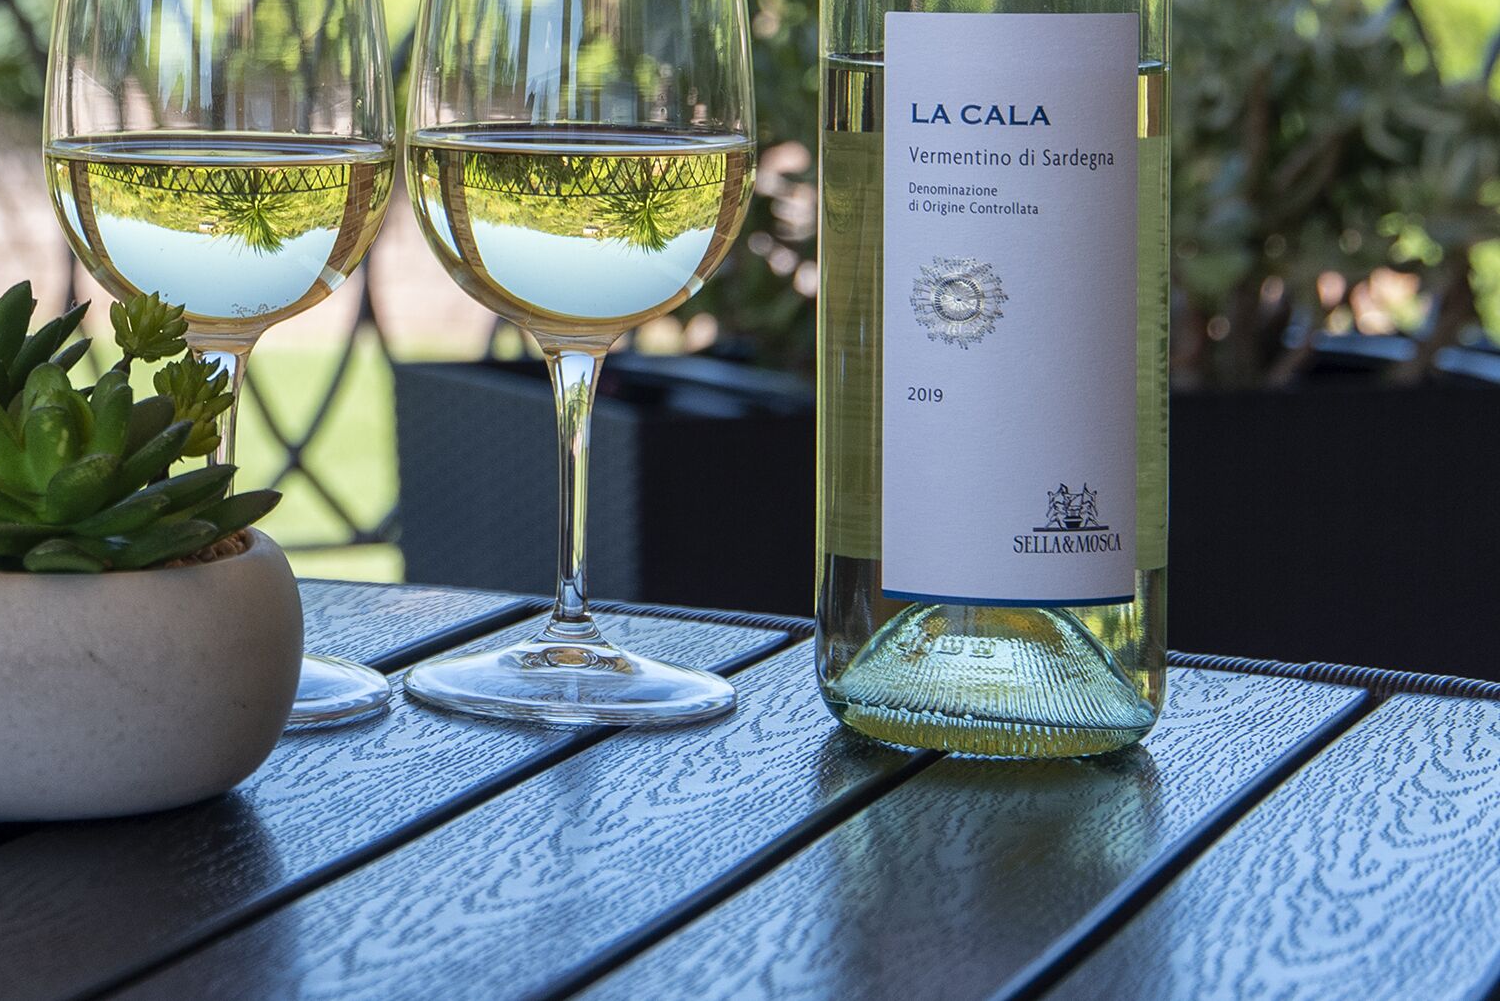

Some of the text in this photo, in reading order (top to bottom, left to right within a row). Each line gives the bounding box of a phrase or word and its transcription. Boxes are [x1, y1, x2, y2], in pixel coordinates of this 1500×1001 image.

[911, 103, 1051, 126] LA CALA
[908, 146, 1115, 171] Vermentino di Sardegna
[908, 182, 998, 197] Denominazione
[908, 200, 1039, 216] di Origine Controllata
[907, 386, 944, 402] 2019
[1013, 533, 1122, 554] SELLA&MOSCA
